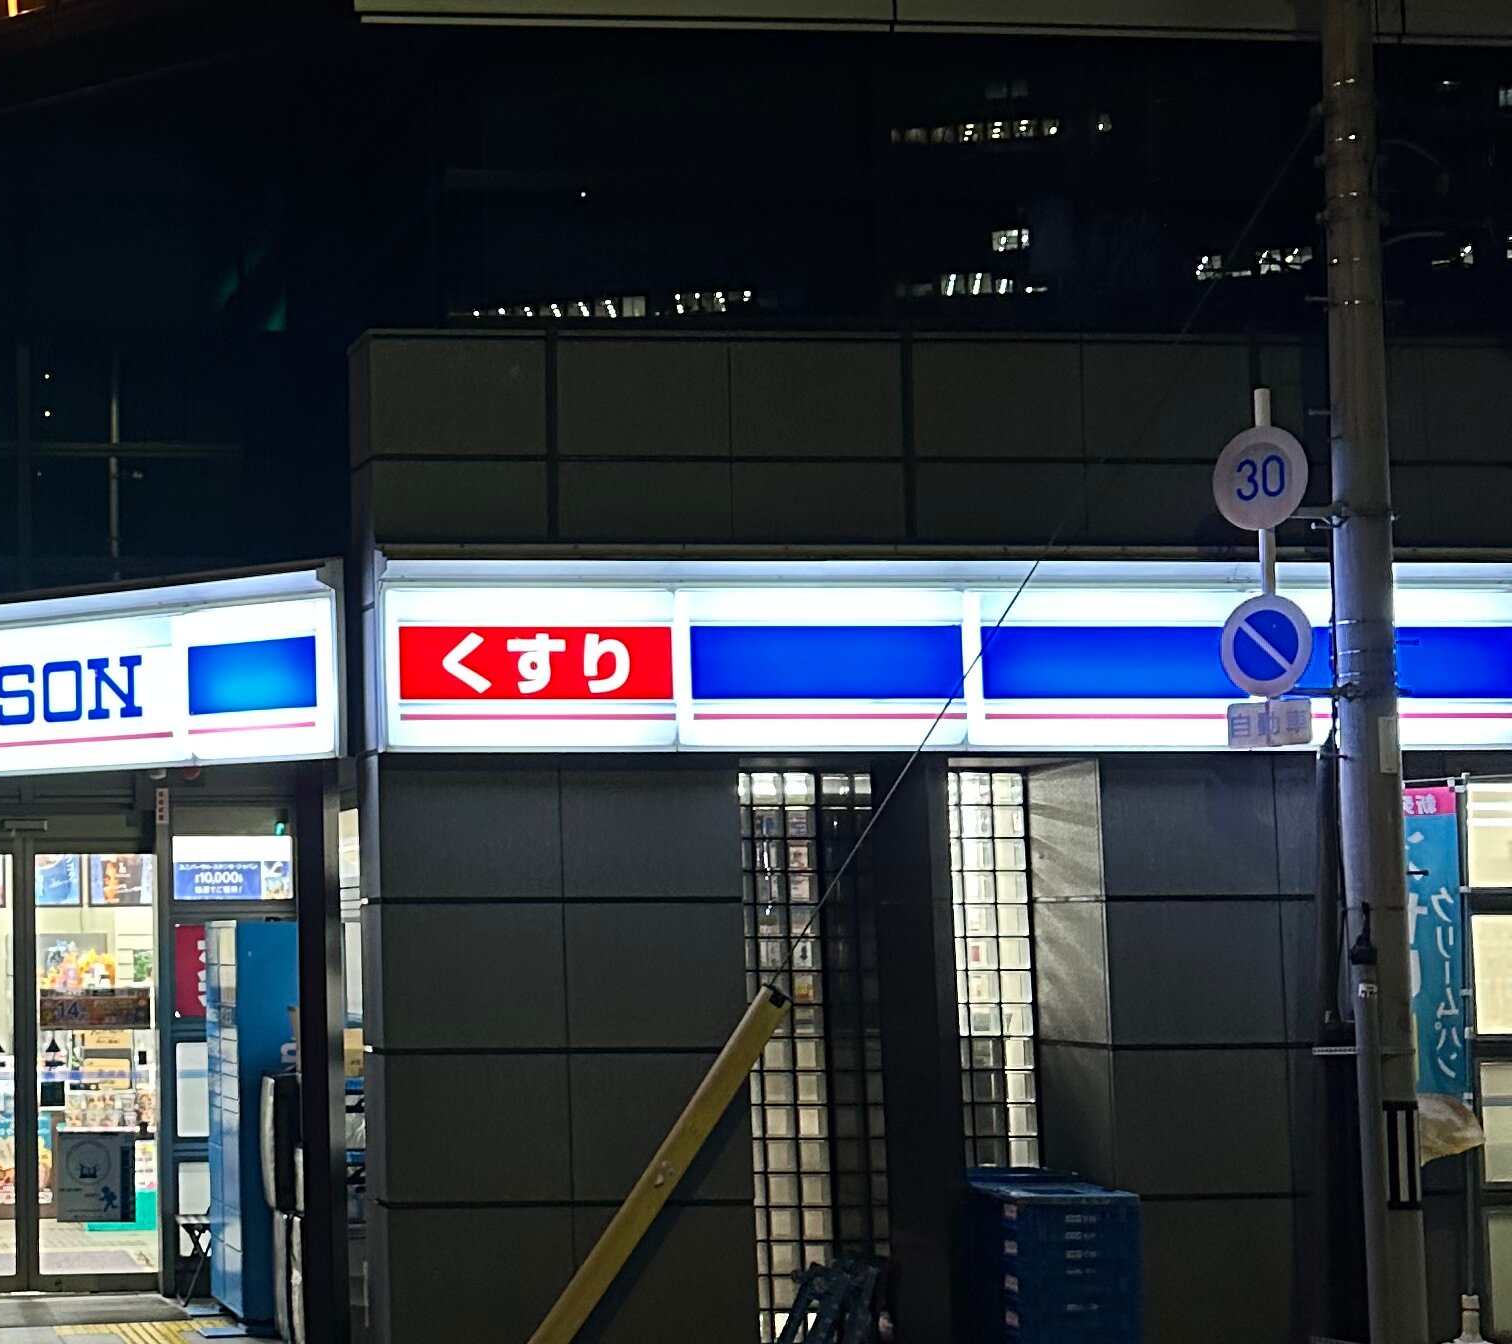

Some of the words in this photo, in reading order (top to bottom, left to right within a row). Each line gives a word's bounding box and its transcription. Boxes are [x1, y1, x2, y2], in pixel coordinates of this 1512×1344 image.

[1236, 455, 1285, 502] 30
[441, 631, 631, 694] くすり
[1231, 710, 1309, 738] 自動車
